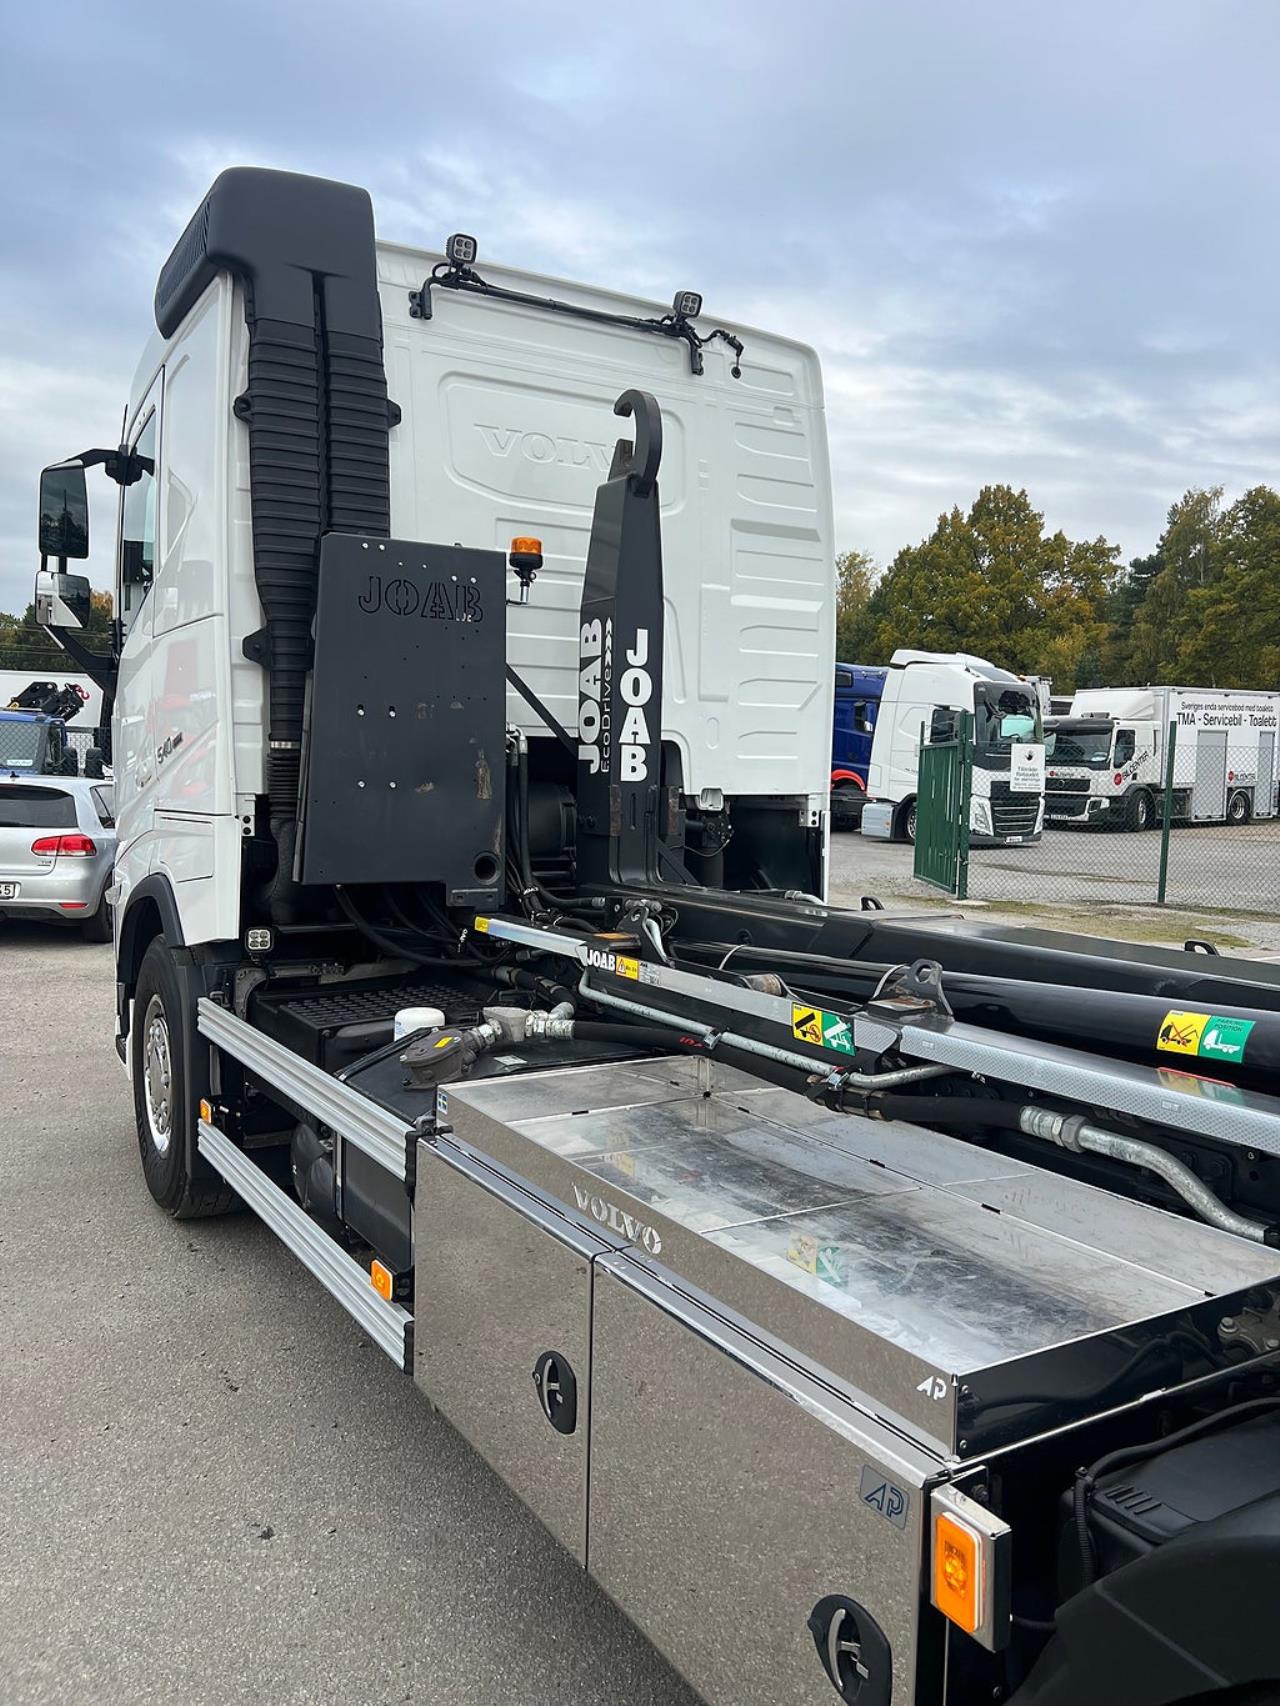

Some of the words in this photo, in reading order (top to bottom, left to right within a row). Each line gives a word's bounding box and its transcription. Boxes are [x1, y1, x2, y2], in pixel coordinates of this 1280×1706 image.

[473, 423, 615, 472] VOLV
[358, 575, 484, 623] JOAB
[578, 618, 602, 774] JOAB
[618, 628, 653, 782] JOAB
[1176, 712, 1196, 725] TMA
[1203, 713, 1242, 726] Servicebil
[1248, 714, 1277, 727] Toalett
[586, 949, 616, 972] JOAB
[571, 1181, 662, 1254] VOLVO
